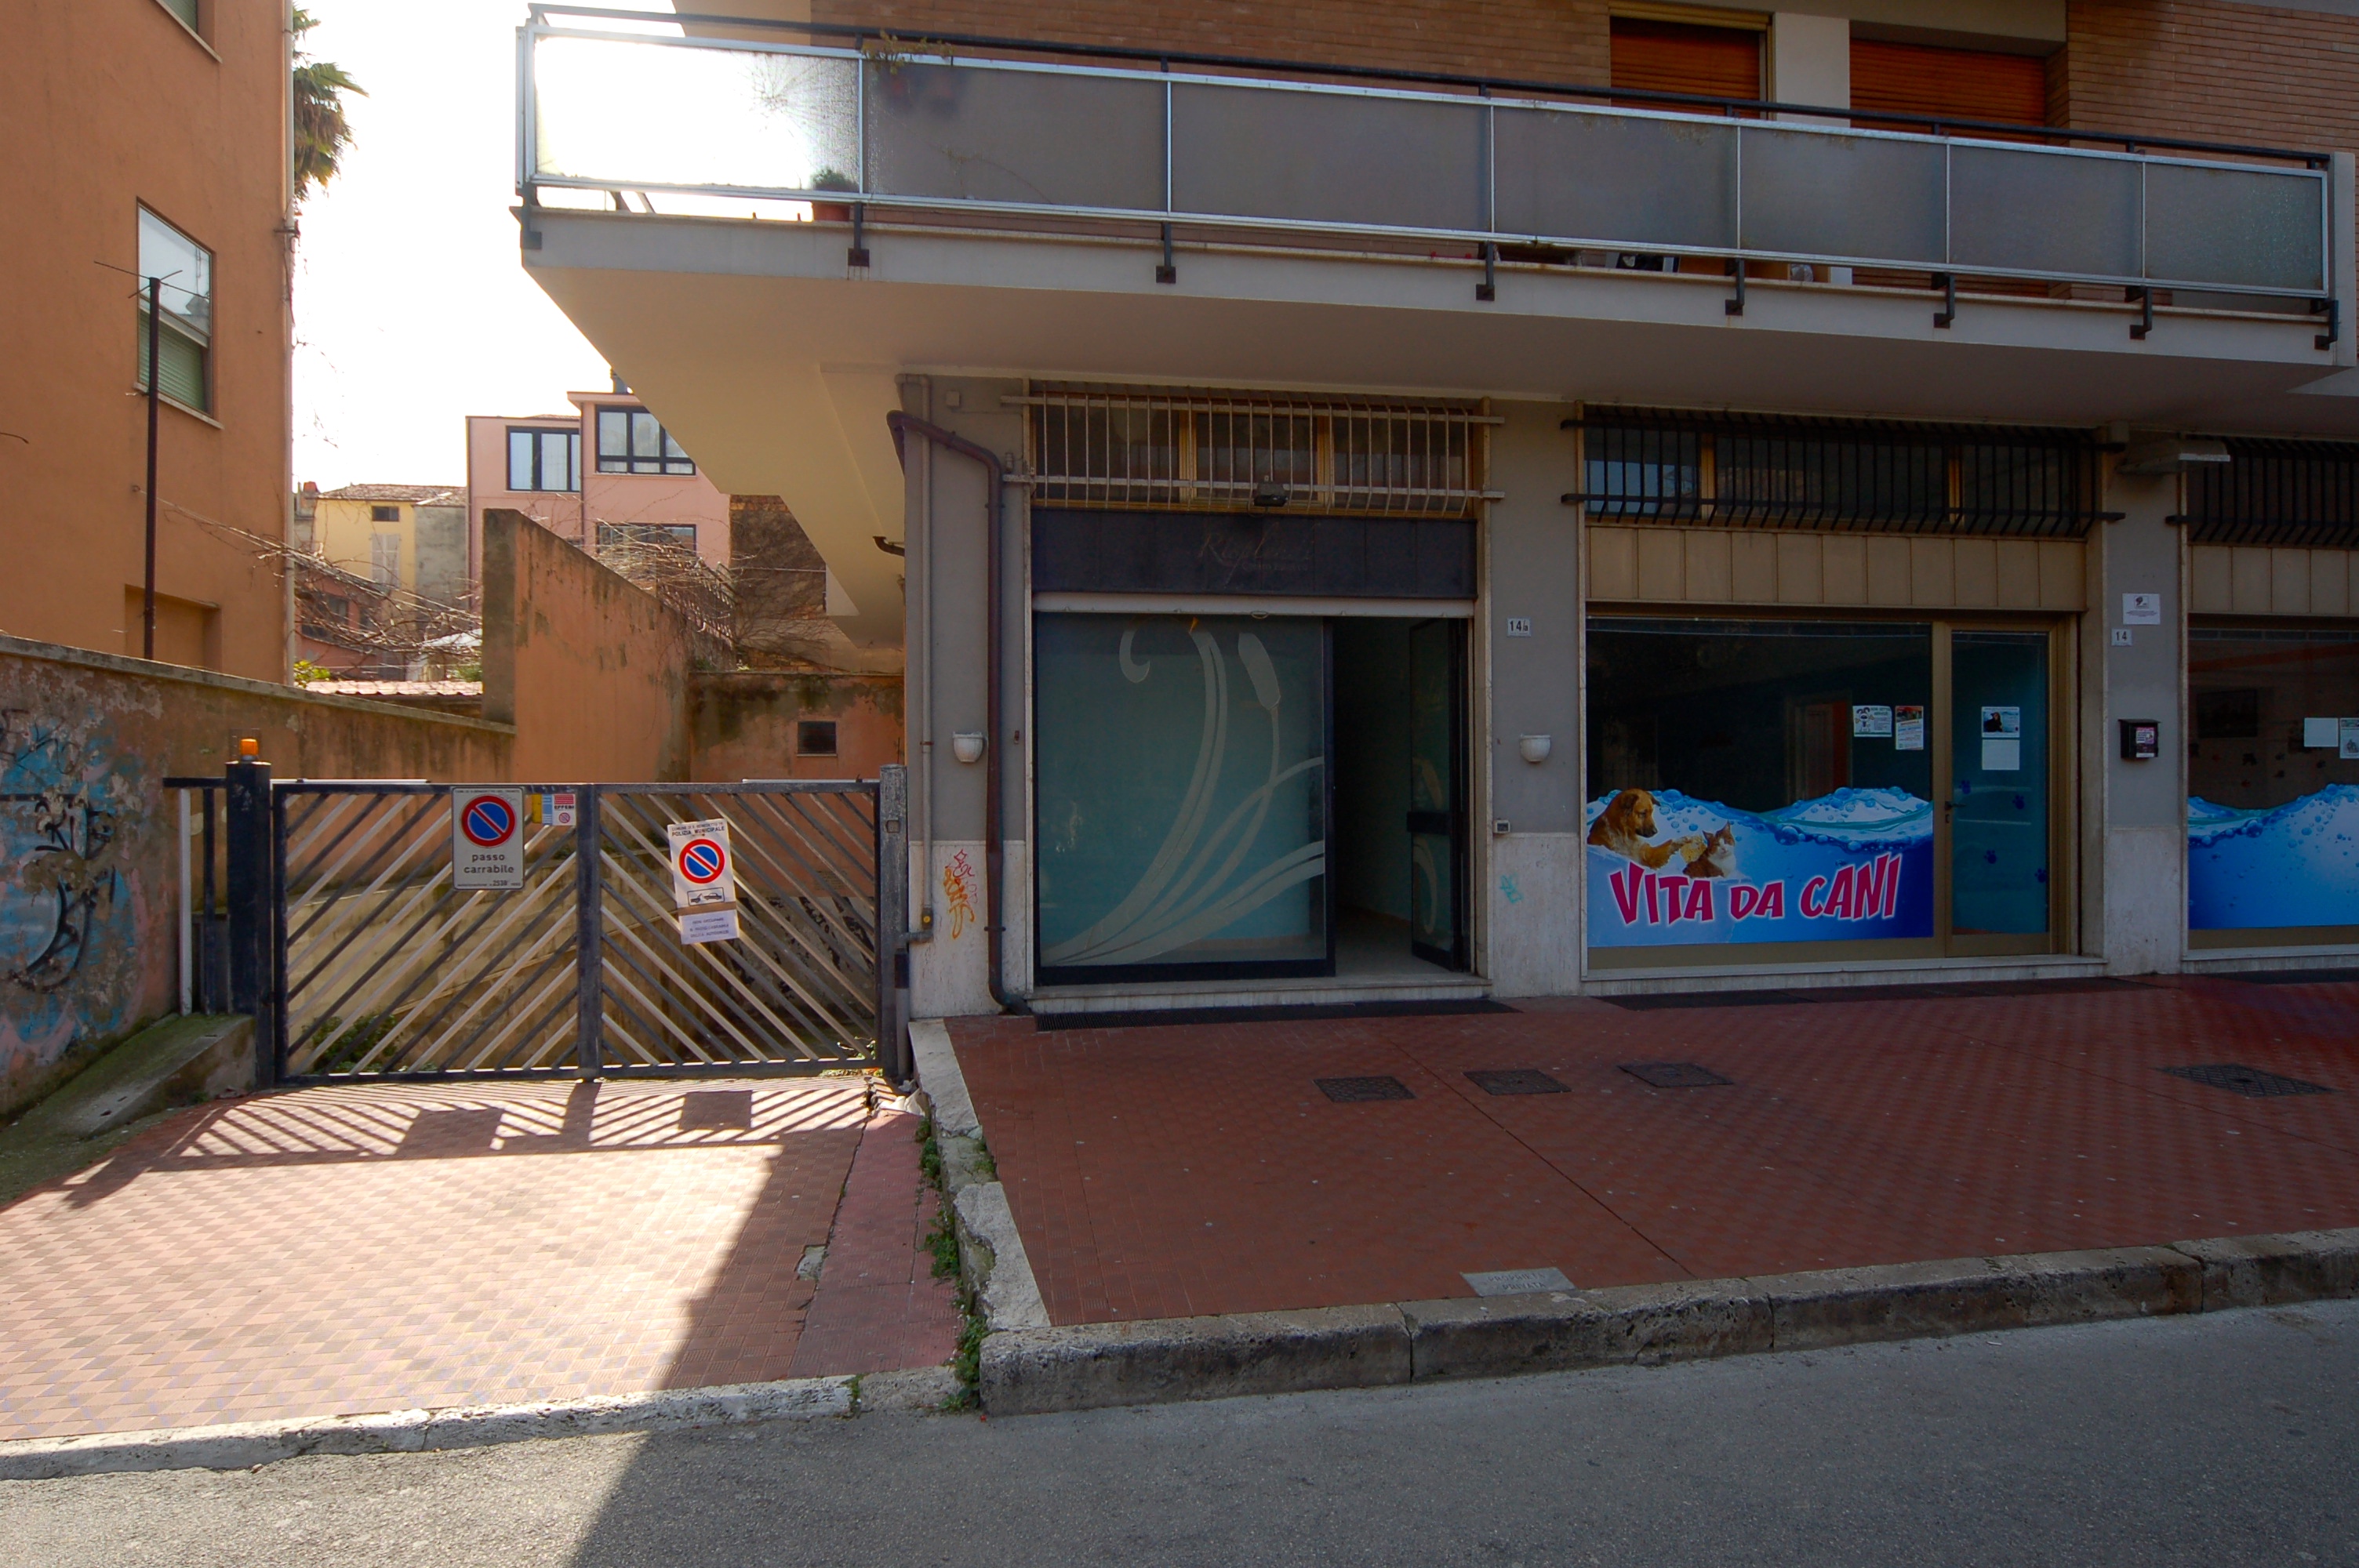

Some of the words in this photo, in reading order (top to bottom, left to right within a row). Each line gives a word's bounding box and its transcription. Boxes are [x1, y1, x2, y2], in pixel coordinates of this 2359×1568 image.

[2116, 630, 2128, 641] 14
[694, 826, 725, 834] MUNICIPALE
[471, 853, 506, 863] passo
[463, 864, 514, 874] carrabile
[1609, 861, 1715, 925] VITA
[1729, 881, 1784, 921] DA
[1799, 853, 1903, 922] CANI
